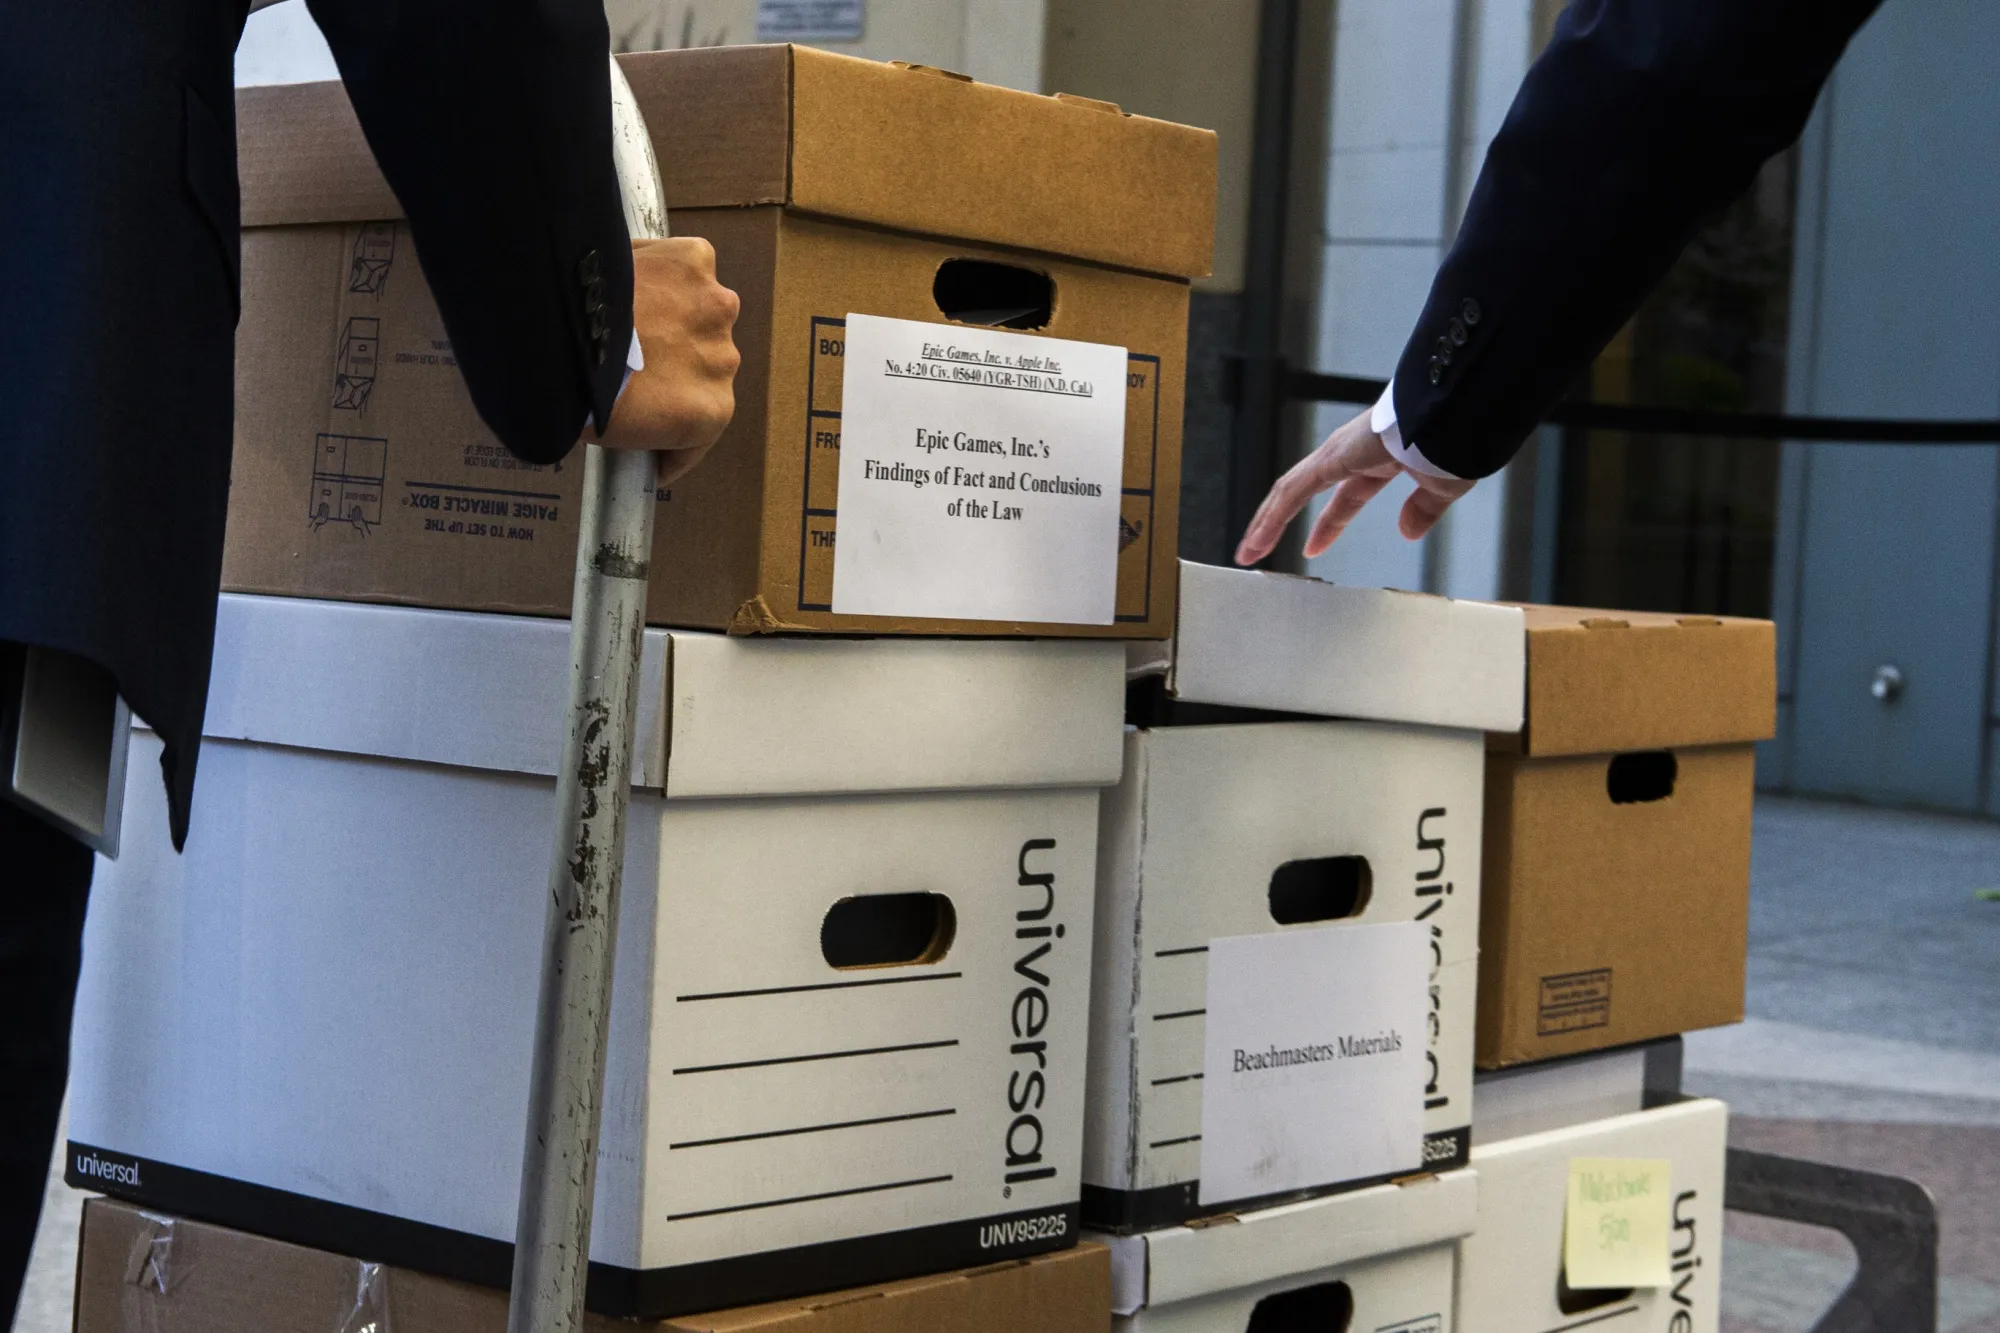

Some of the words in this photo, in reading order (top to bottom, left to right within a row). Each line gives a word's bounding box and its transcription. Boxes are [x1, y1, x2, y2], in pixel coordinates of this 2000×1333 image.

[921, 342, 944, 359] Epic
[984, 350, 1002, 365] Inc.
[1004, 356, 1013, 366] v.
[1015, 354, 1042, 371] Apple
[1044, 358, 1062, 372] Inc.
[885, 359, 903, 375] No.
[905, 362, 928, 377] 4:20
[929, 364, 950, 380] Civ.
[952, 368, 982, 383] 05640
[983, 370, 1042, 391] (YGR-TSH)
[1043, 377, 1069, 393] (N.D.
[1070, 380, 1093, 396] Cal.)
[916, 428, 949, 454] Epic
[953, 432, 1007, 459] Games,
[1011, 436, 1050, 459] Inc.'s
[864, 459, 931, 488] Findings
[934, 466, 951, 485] of
[952, 467, 985, 488] Fact
[988, 471, 1016, 490] and
[1019, 472, 1103, 498] Conclusions
[444, 496, 508, 516] MIRACLE
[513, 503, 558, 521] PAIGE
[947, 498, 964, 517] of
[966, 499, 988, 519] the
[992, 500, 1024, 521] Law
[424, 518, 445, 532] THE
[448, 521, 463, 533] UP
[466, 523, 487, 535] SET
[489, 525, 504, 537] TO
[507, 526, 534, 540] HOW
[1004, 838, 1065, 1185] universal
[1233, 1044, 1334, 1073] Beachmasters
[1337, 1029, 1402, 1059] Materials
[77, 1152, 138, 1186] universal
[980, 1213, 1067, 1248] UNV95225
